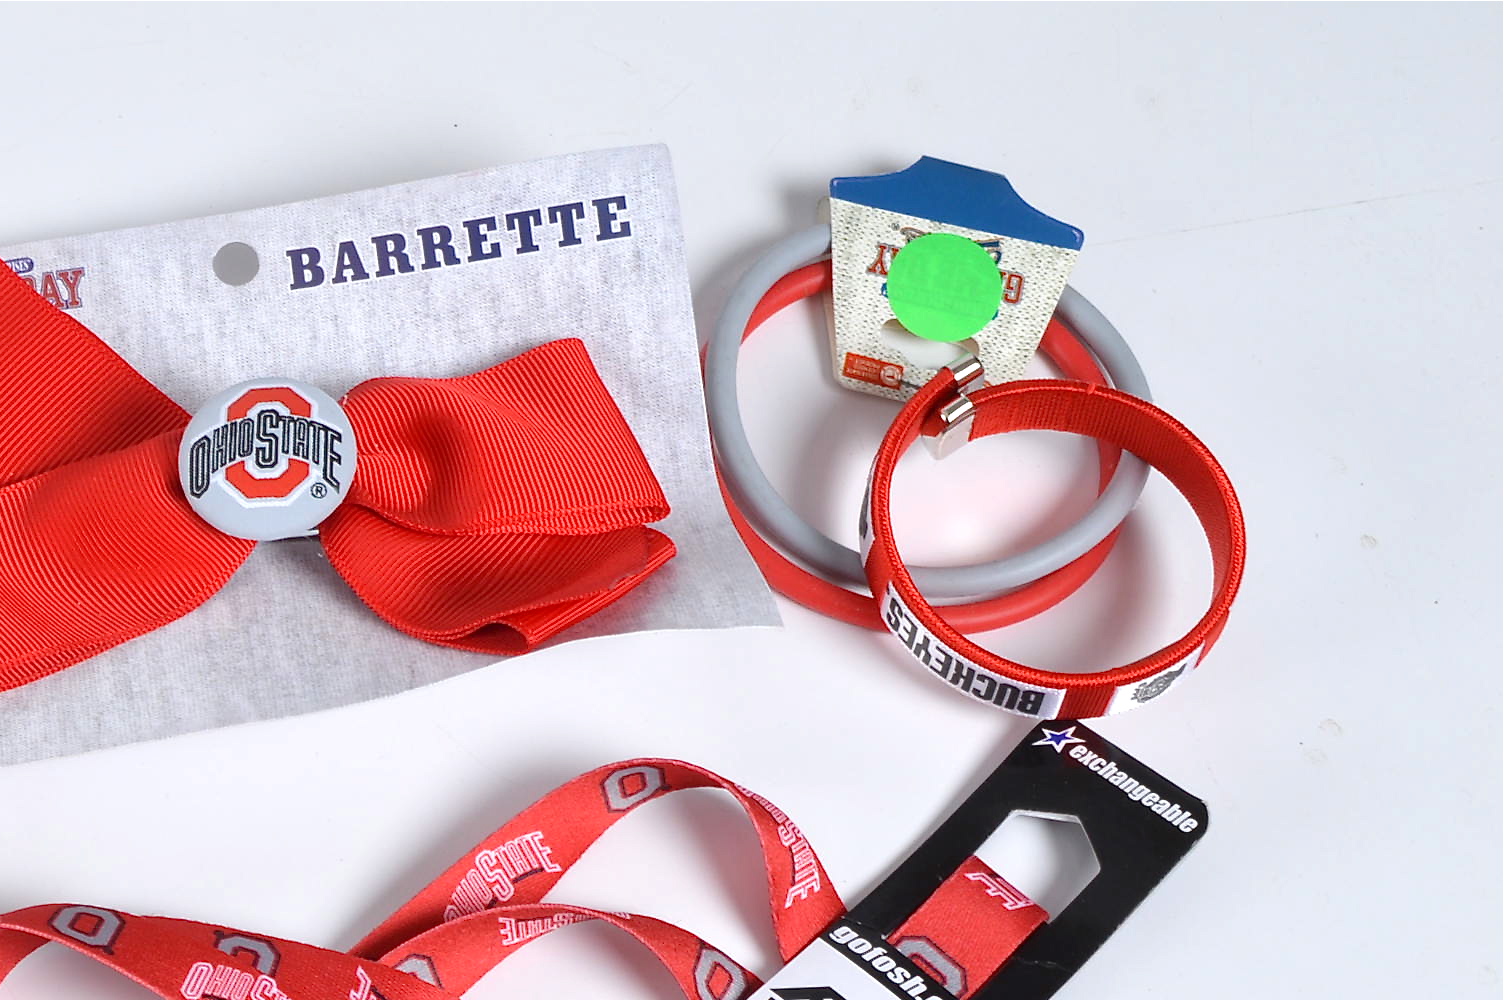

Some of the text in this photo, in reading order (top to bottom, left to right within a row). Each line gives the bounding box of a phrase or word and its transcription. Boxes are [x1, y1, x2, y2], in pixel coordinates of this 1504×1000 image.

[285, 194, 634, 292] BARRETTE
[886, 596, 1045, 716] BUCKEYES
[1069, 740, 1199, 835] exchangeable
